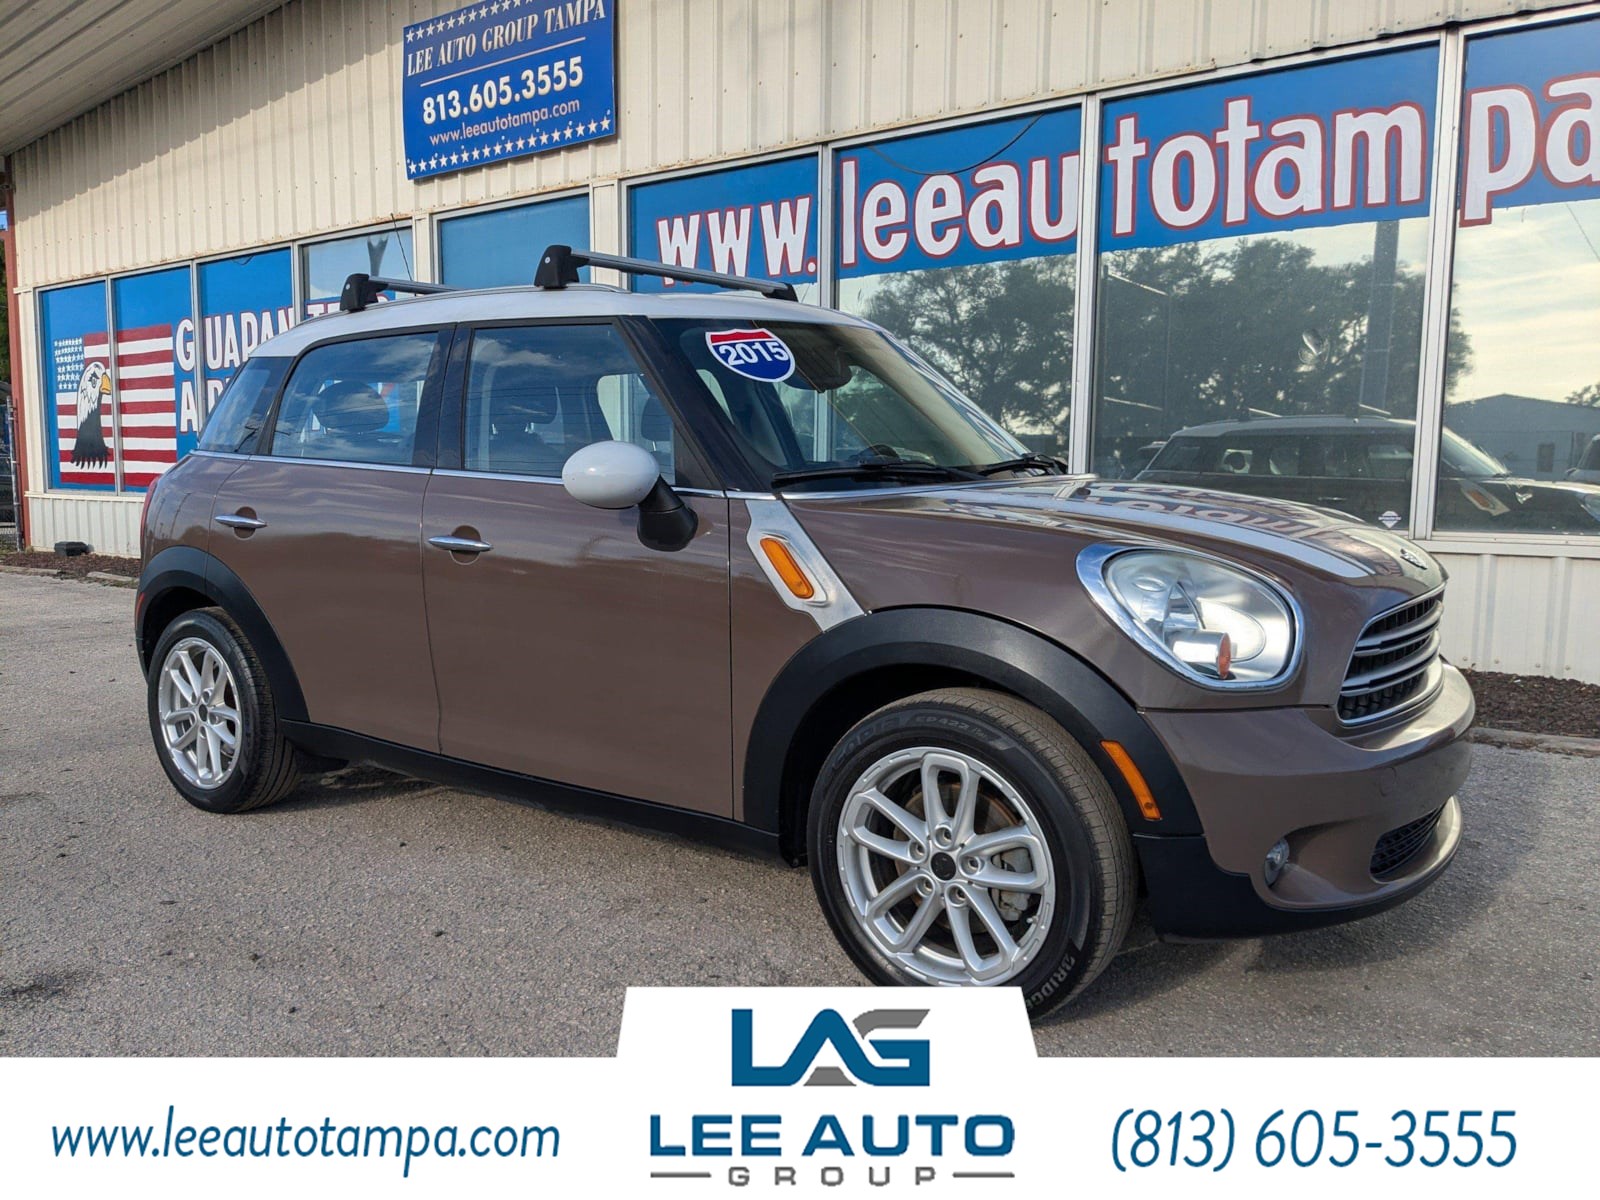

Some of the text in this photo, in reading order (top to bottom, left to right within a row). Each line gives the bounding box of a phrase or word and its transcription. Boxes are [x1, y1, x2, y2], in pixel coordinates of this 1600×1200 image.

[406, 0, 606, 77] LEE AUTO GROUP TAMPA
[423, 56, 583, 125] 813.605.3555
[429, 99, 580, 146] www.leeautotampa.com
[718, 341, 789, 366] 2015
